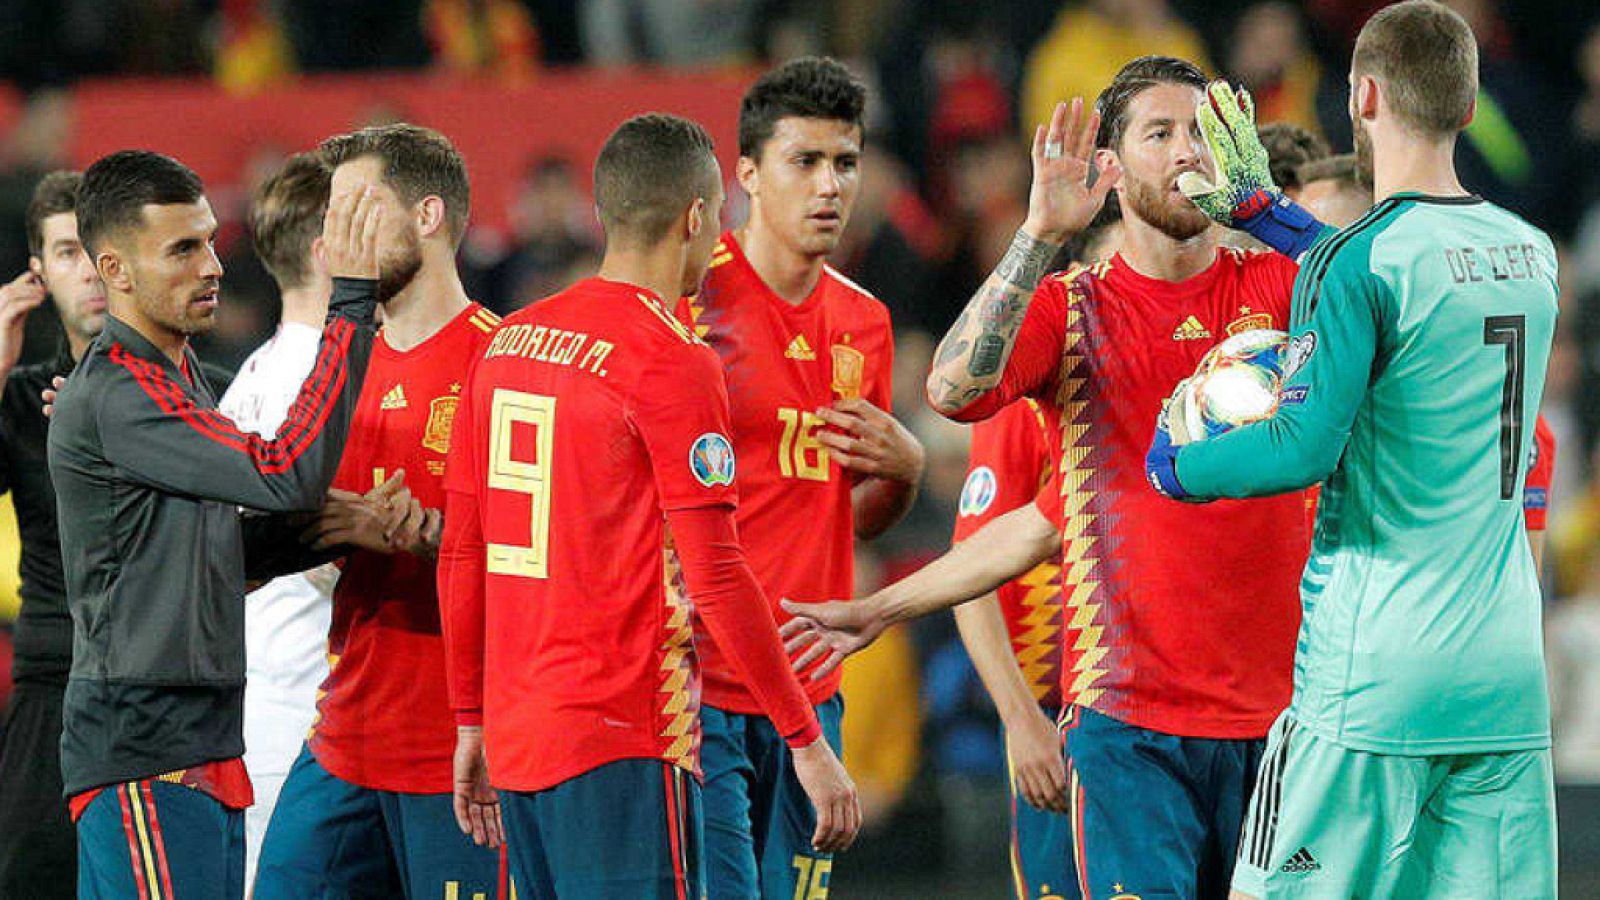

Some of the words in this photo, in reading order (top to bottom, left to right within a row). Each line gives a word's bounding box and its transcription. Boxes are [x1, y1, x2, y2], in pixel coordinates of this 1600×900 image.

[1445, 247, 1483, 283] DE
[485, 323, 587, 365] RODRIGO
[578, 340, 615, 377] M.
[777, 407, 831, 482] 16
[1484, 314, 1526, 500] 1
[487, 388, 557, 579] 9
